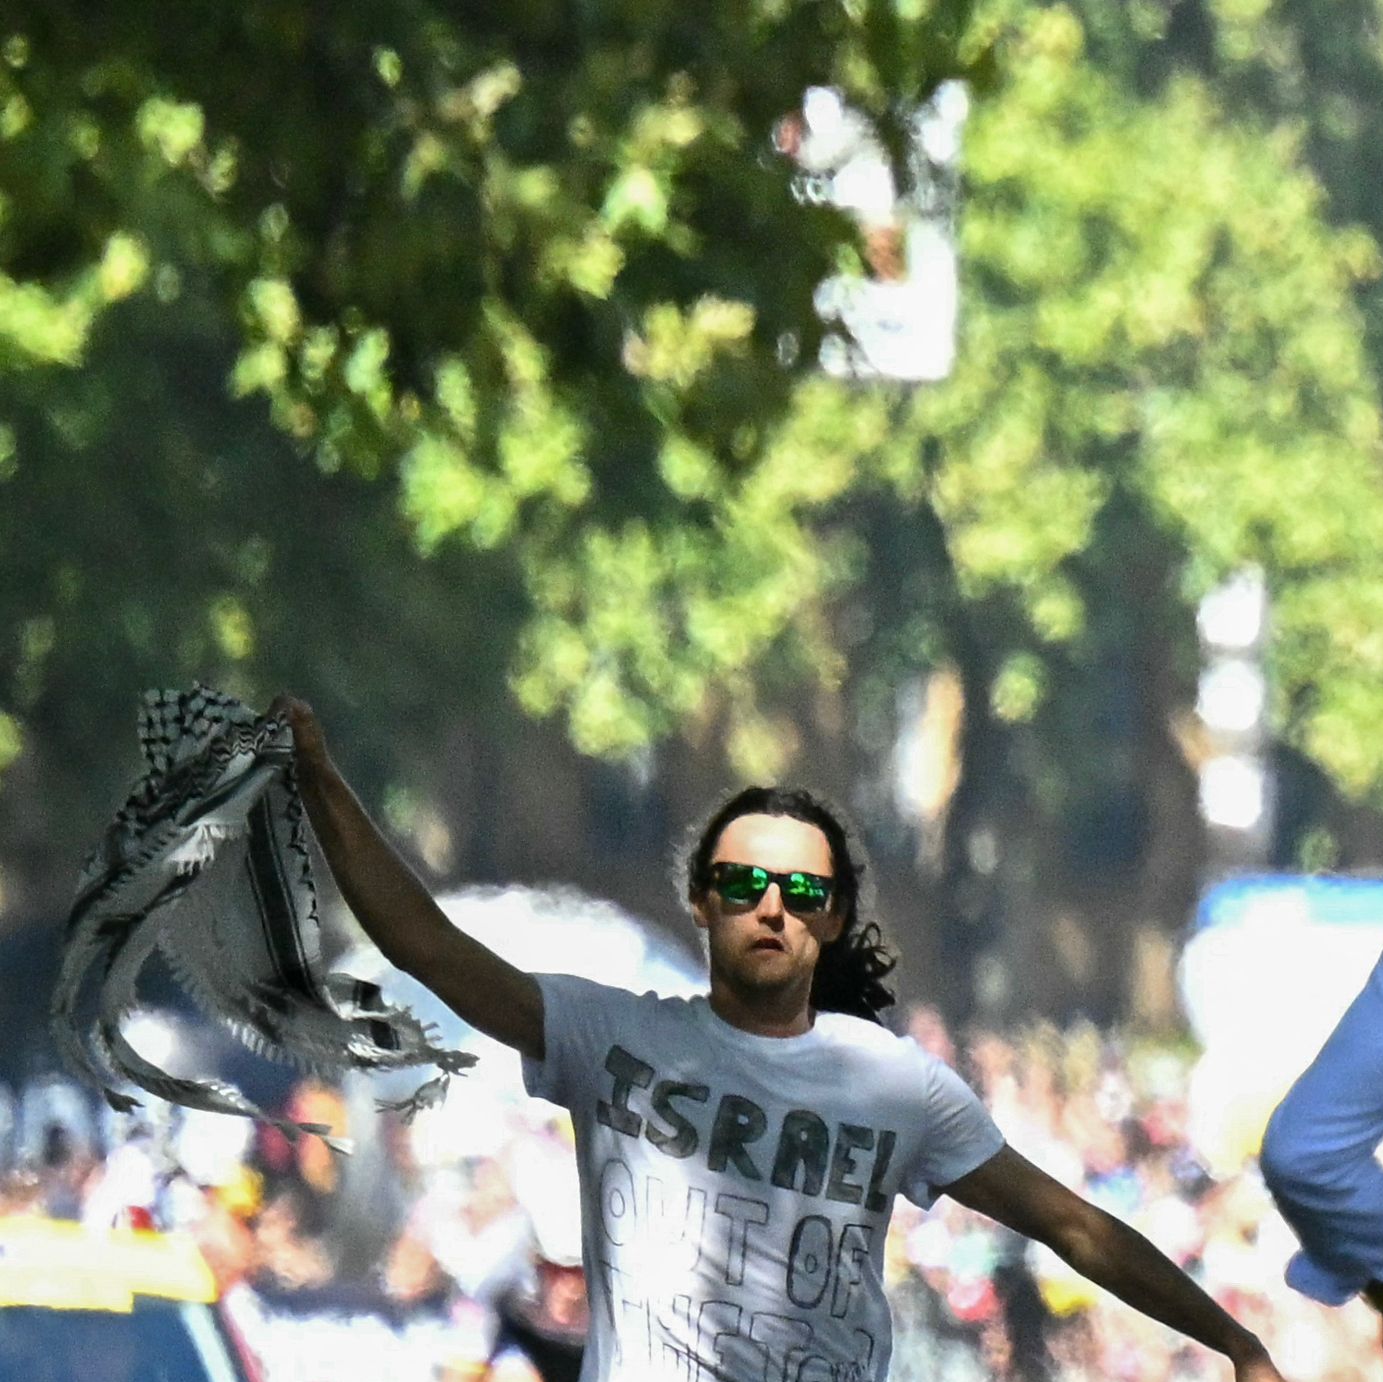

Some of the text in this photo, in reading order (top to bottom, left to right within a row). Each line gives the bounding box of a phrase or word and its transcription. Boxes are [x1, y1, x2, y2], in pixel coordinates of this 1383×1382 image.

[597, 1044, 897, 1213] ISRAEL
[599, 1157, 873, 1319] OUT OF
